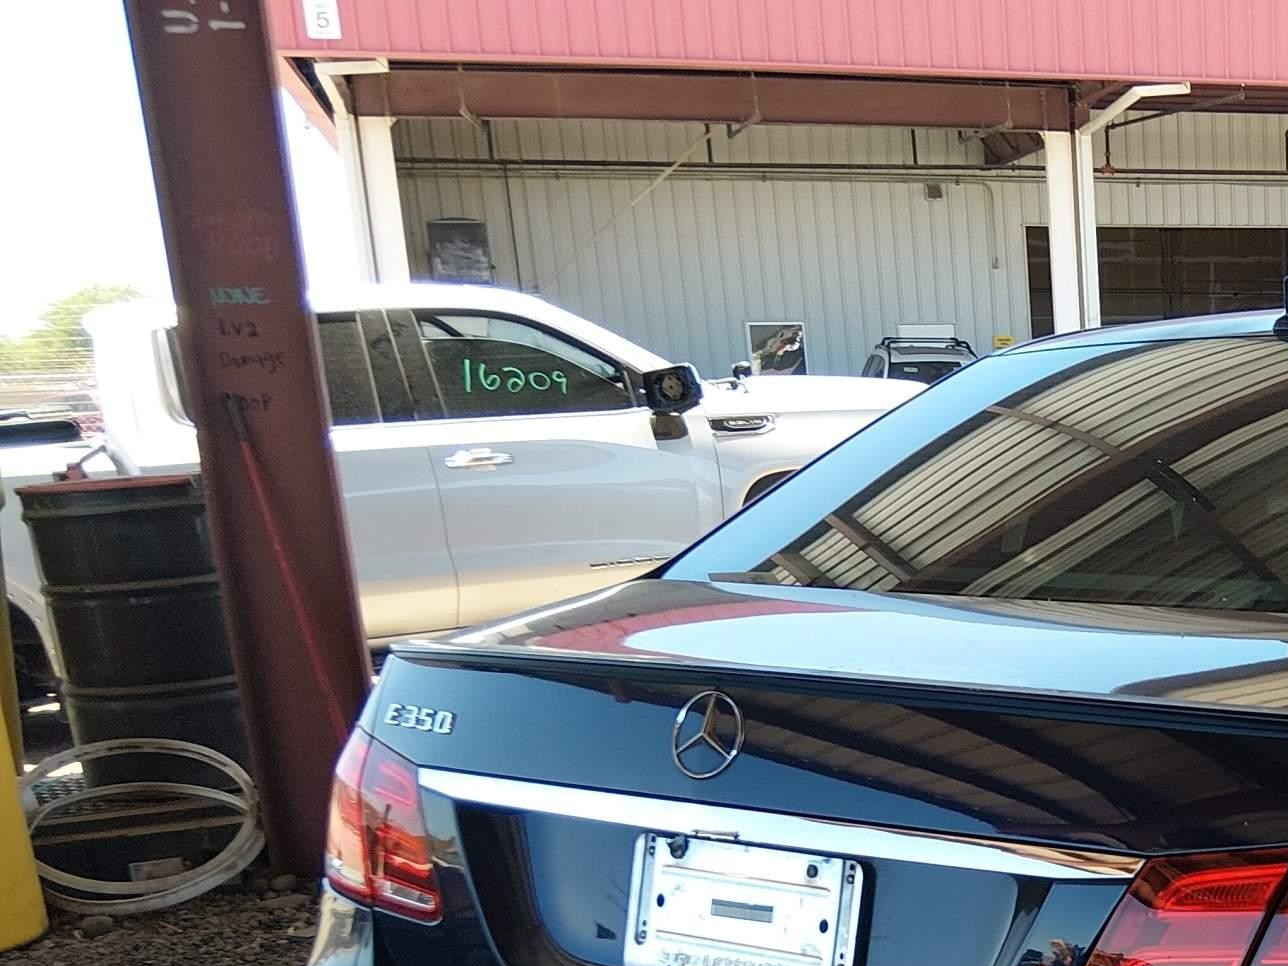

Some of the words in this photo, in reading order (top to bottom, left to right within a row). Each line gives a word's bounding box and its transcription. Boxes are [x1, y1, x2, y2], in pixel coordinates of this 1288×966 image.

[315, 11, 330, 28] 5
[464, 359, 567, 394] 16209
[384, 703, 454, 734] E350
